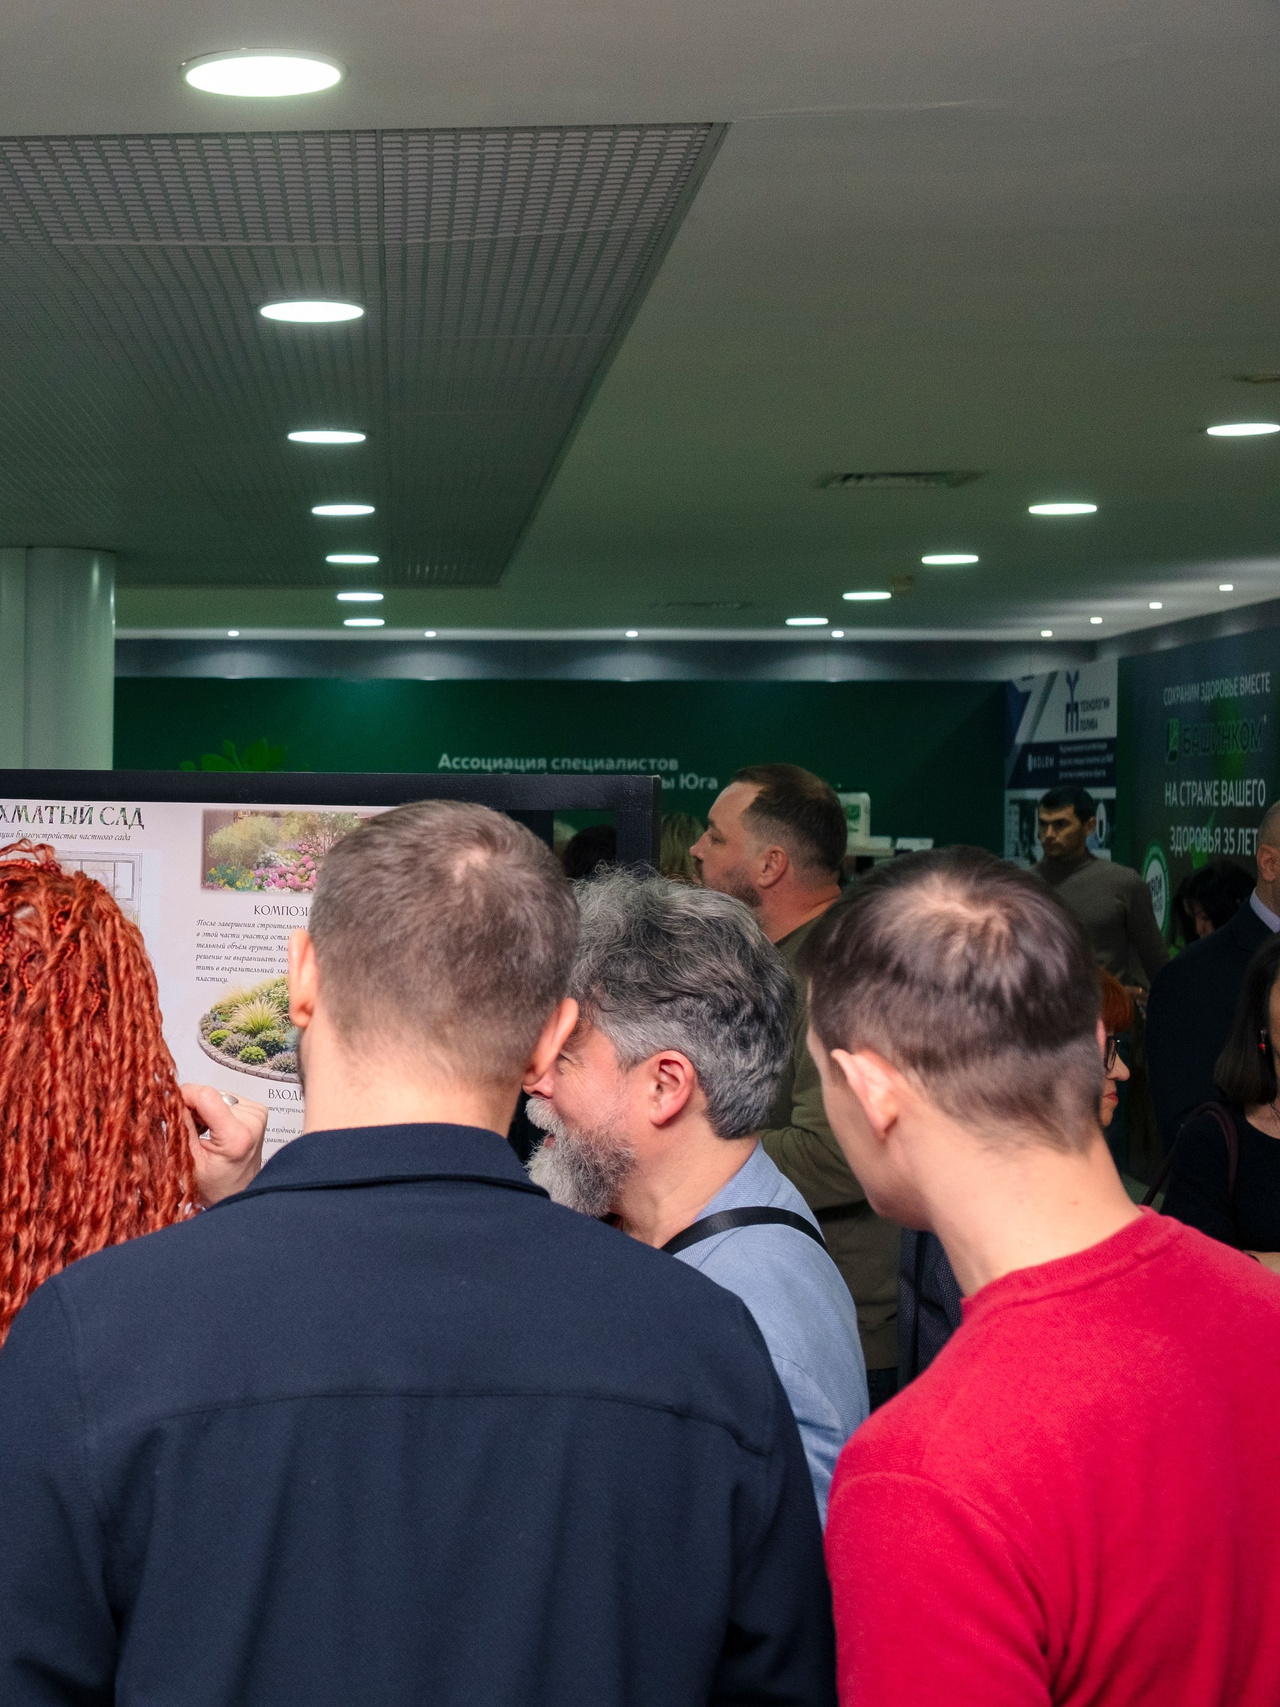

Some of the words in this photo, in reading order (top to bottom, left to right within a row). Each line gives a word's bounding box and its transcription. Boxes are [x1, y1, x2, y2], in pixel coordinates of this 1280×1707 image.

[1200, 676, 1239, 705] ЗДОРОВЬЕ
[1240, 671, 1271, 696] ВМЕСТЕ
[438, 753, 548, 773] Ассоциация
[551, 757, 679, 773] специалистов
[679, 773, 718, 790] Юга
[1164, 781, 1178, 807] НА
[1179, 780, 1220, 807] СТРАЖЕ
[1221, 778, 1266, 807] ВАШЕГО
[99, 806, 145, 830] САД
[16, 830, 77, 841] благоустройства
[79, 833, 114, 841] частного
[114, 833, 131, 841] сада
[1170, 825, 1221, 857] ЗДОРОВЬЯ
[1223, 827, 1236, 855] 35
[1237, 827, 1259, 857] ЛЕТ
[196, 919, 216, 927] После
[220, 966, 274, 974] выразительный
